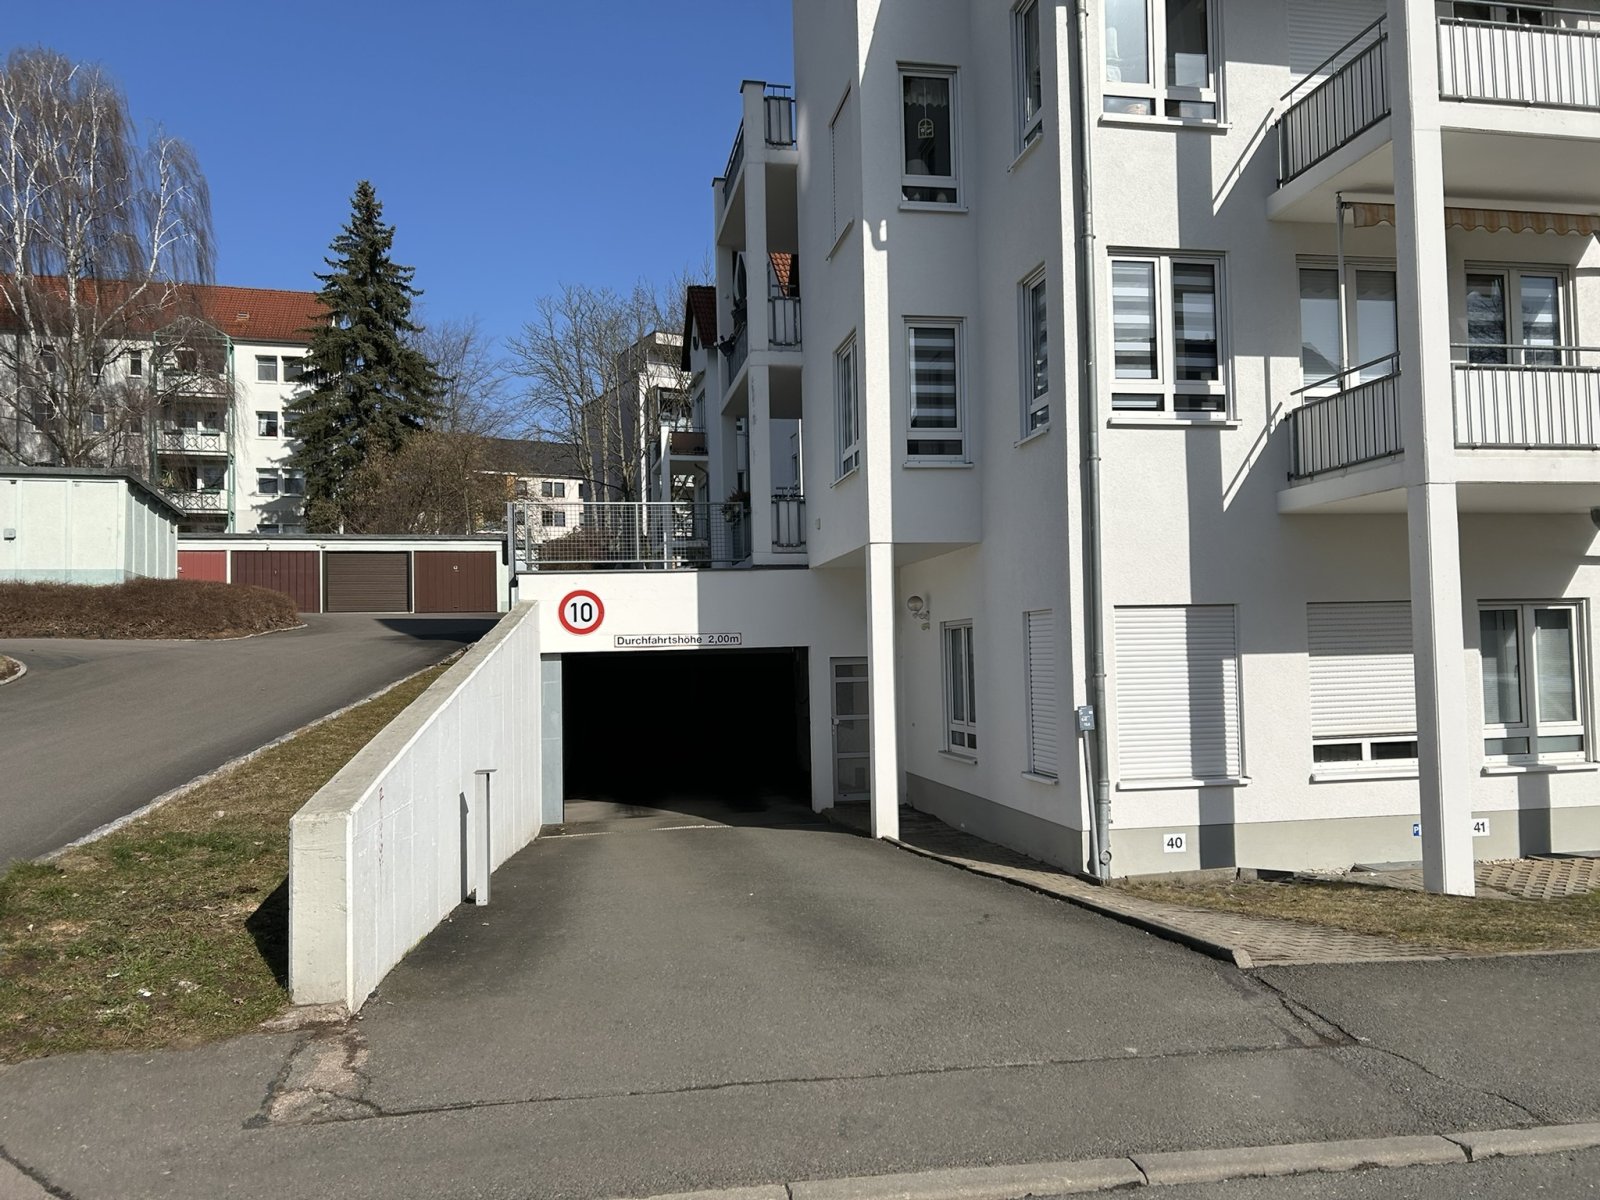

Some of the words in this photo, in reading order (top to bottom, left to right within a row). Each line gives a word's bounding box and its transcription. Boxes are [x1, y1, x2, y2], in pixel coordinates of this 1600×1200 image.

[570, 602, 593, 623] 10
[617, 634, 702, 645] Durchfahrtshöhe
[708, 634, 739, 645] 2,00m
[1473, 821, 1486, 833] 41
[1166, 836, 1183, 849] 40
